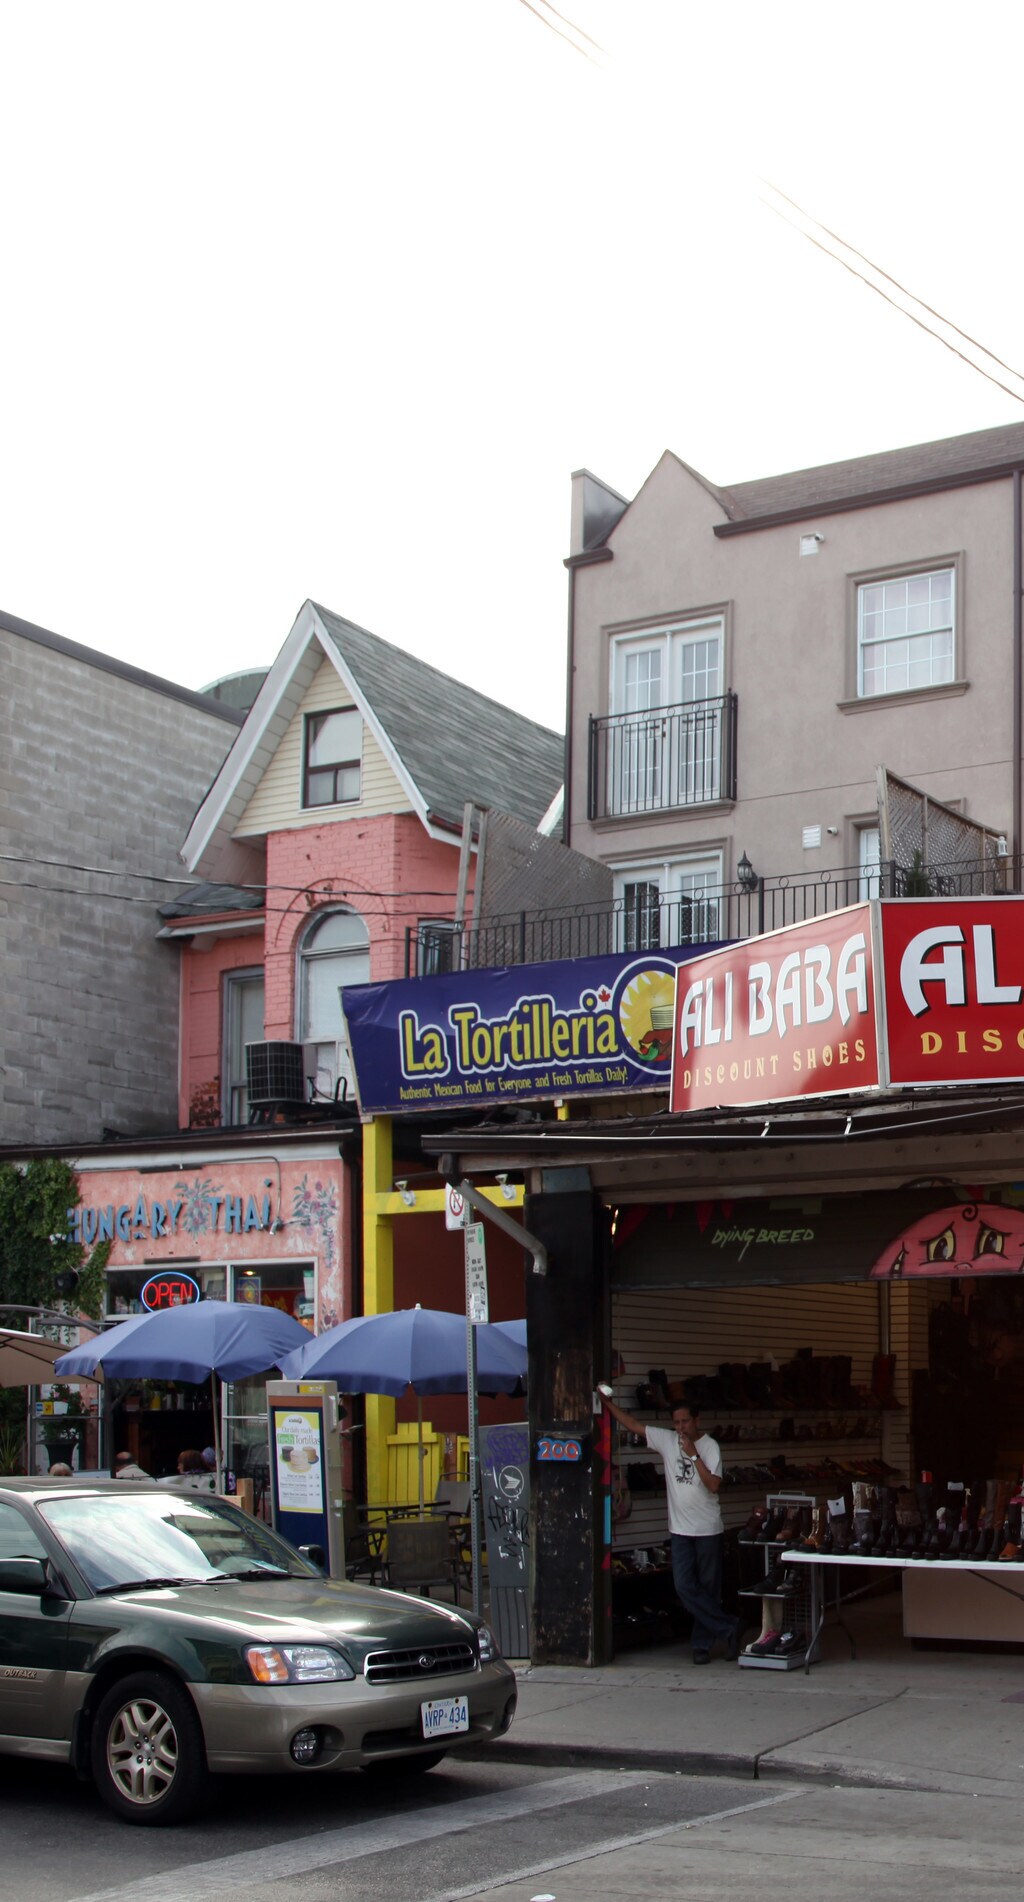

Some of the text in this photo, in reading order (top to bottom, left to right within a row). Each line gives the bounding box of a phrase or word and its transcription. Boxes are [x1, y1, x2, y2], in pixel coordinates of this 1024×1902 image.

[680, 932, 868, 1058] ALI BABA
[402, 995, 620, 1075] La Tortilleria
[683, 1039, 866, 1089] DISCOUNT SHOES
[400, 1066, 628, 1100] Authentic Mexican Food for Everyone and Fresh Tortillas Daily!
[66, 1193, 271, 1245] HUNGARY THAI
[755, 1228, 815, 1244] BREED
[144, 1282, 193, 1308] OPEN
[295, 1434, 320, 1445] Tortillas
[539, 1441, 579, 1459] 200
[4, 1669, 37, 1680] OUTBACK
[425, 1705, 466, 1729] AVRP 434
